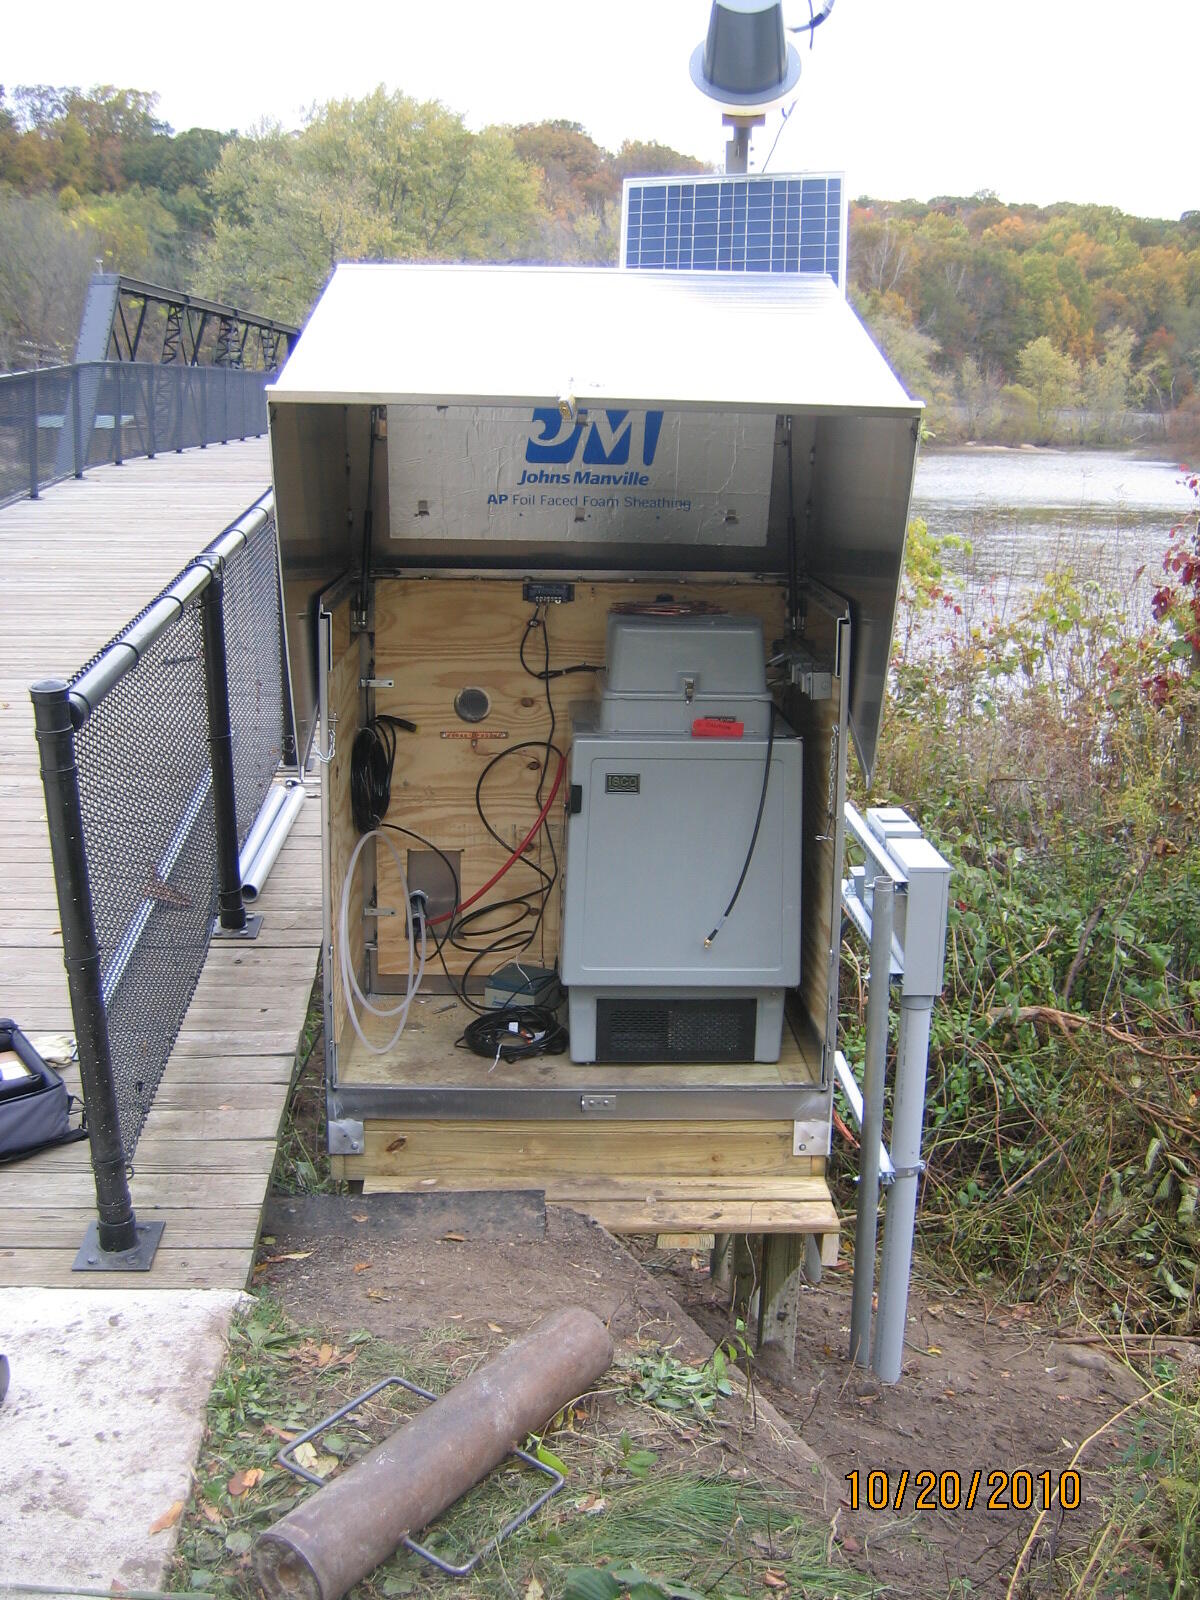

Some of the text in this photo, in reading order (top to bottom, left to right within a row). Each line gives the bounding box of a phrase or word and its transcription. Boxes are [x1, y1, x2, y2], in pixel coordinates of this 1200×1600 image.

[517, 470, 650, 486] Johns Manville
[487, 494, 692, 511] AP Foil Faced Foam Sheathing
[608, 776, 638, 787] ISCO
